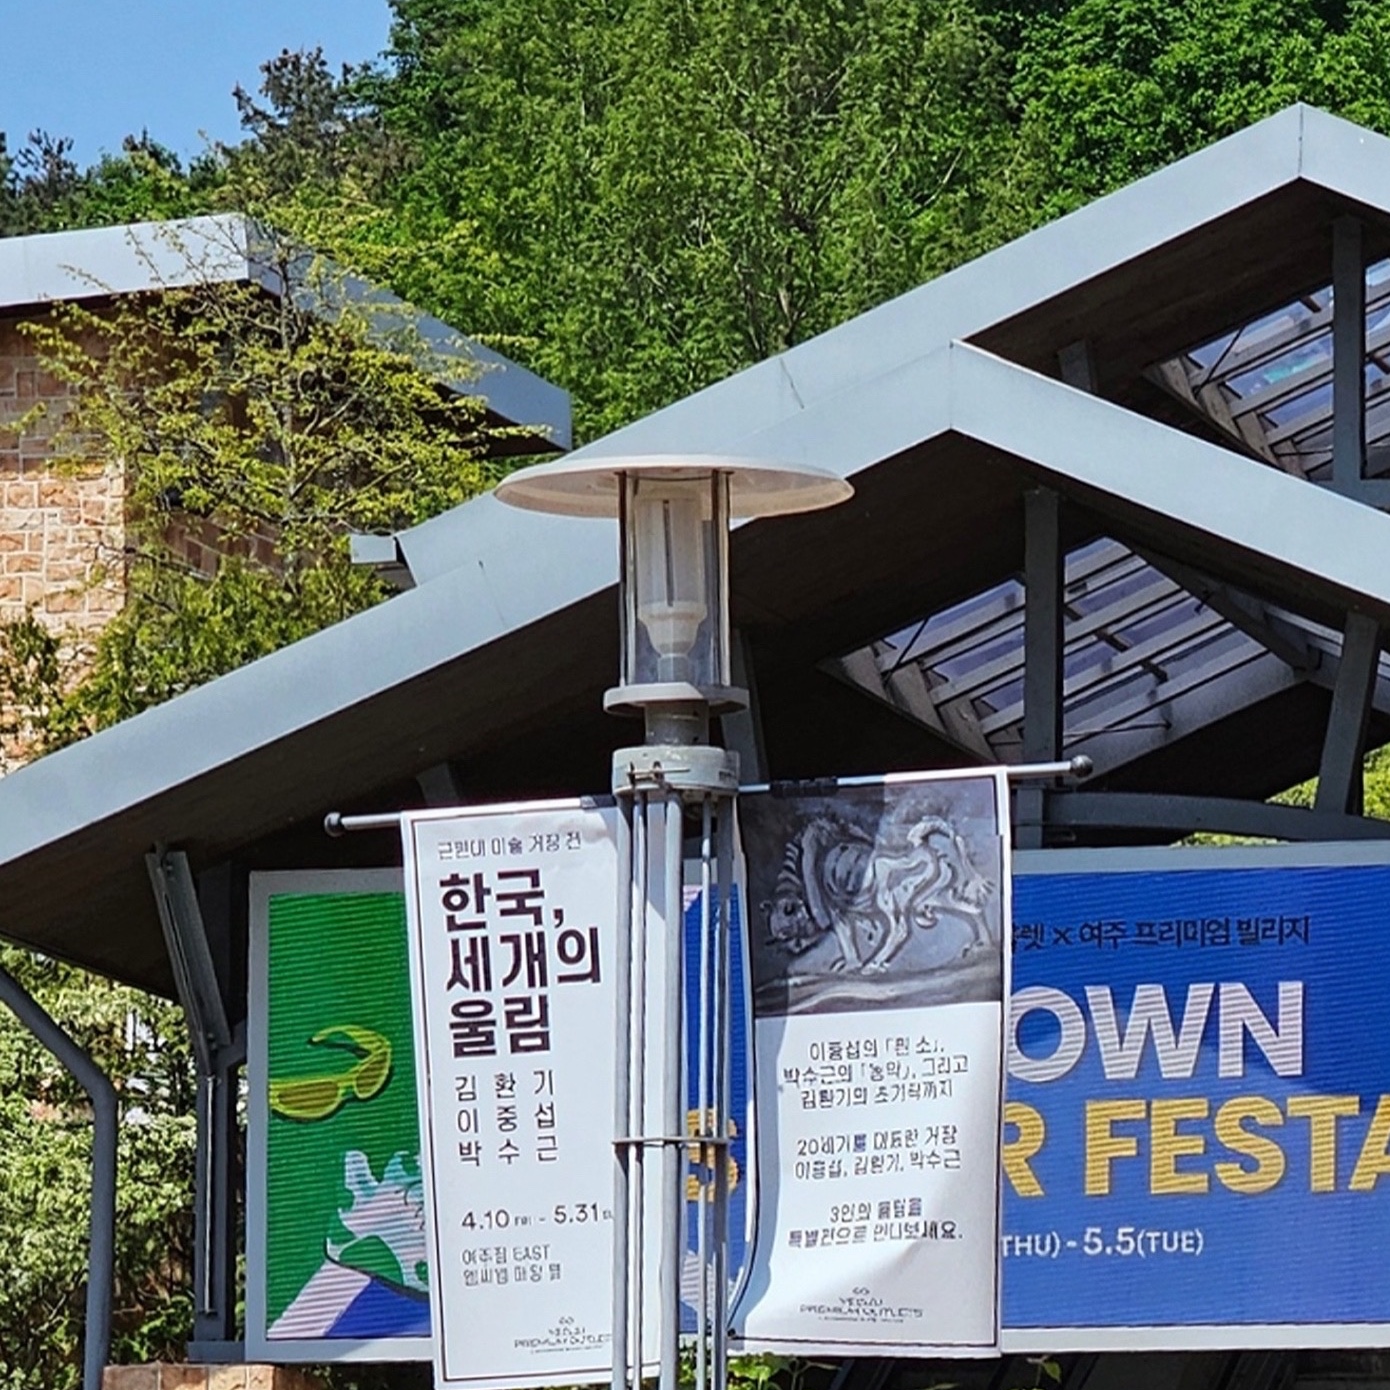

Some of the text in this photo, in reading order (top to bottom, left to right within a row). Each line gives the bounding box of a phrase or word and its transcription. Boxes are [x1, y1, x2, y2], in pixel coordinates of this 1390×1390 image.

[529, 833, 560, 852] 거장
[566, 831, 581, 850] 전
[439, 869, 565, 933] 한국,
[1078, 919, 1128, 950] 여주
[1133, 917, 1231, 949] 프리미엄
[1235, 914, 1311, 947] 빌리지
[449, 994, 551, 1059] 울림
[921, 1054, 969, 1078] 그리고
[924, 1124, 958, 1146] 거장
[909, 1148, 962, 1171] 박수근
[461, 1208, 510, 1231] 4.10
[553, 1202, 599, 1225] 5.31
[829, 1202, 872, 1224] 3인의
[512, 1244, 552, 1262] EAST
[1083, 1226, 1204, 1259] 5.5(TUE)
